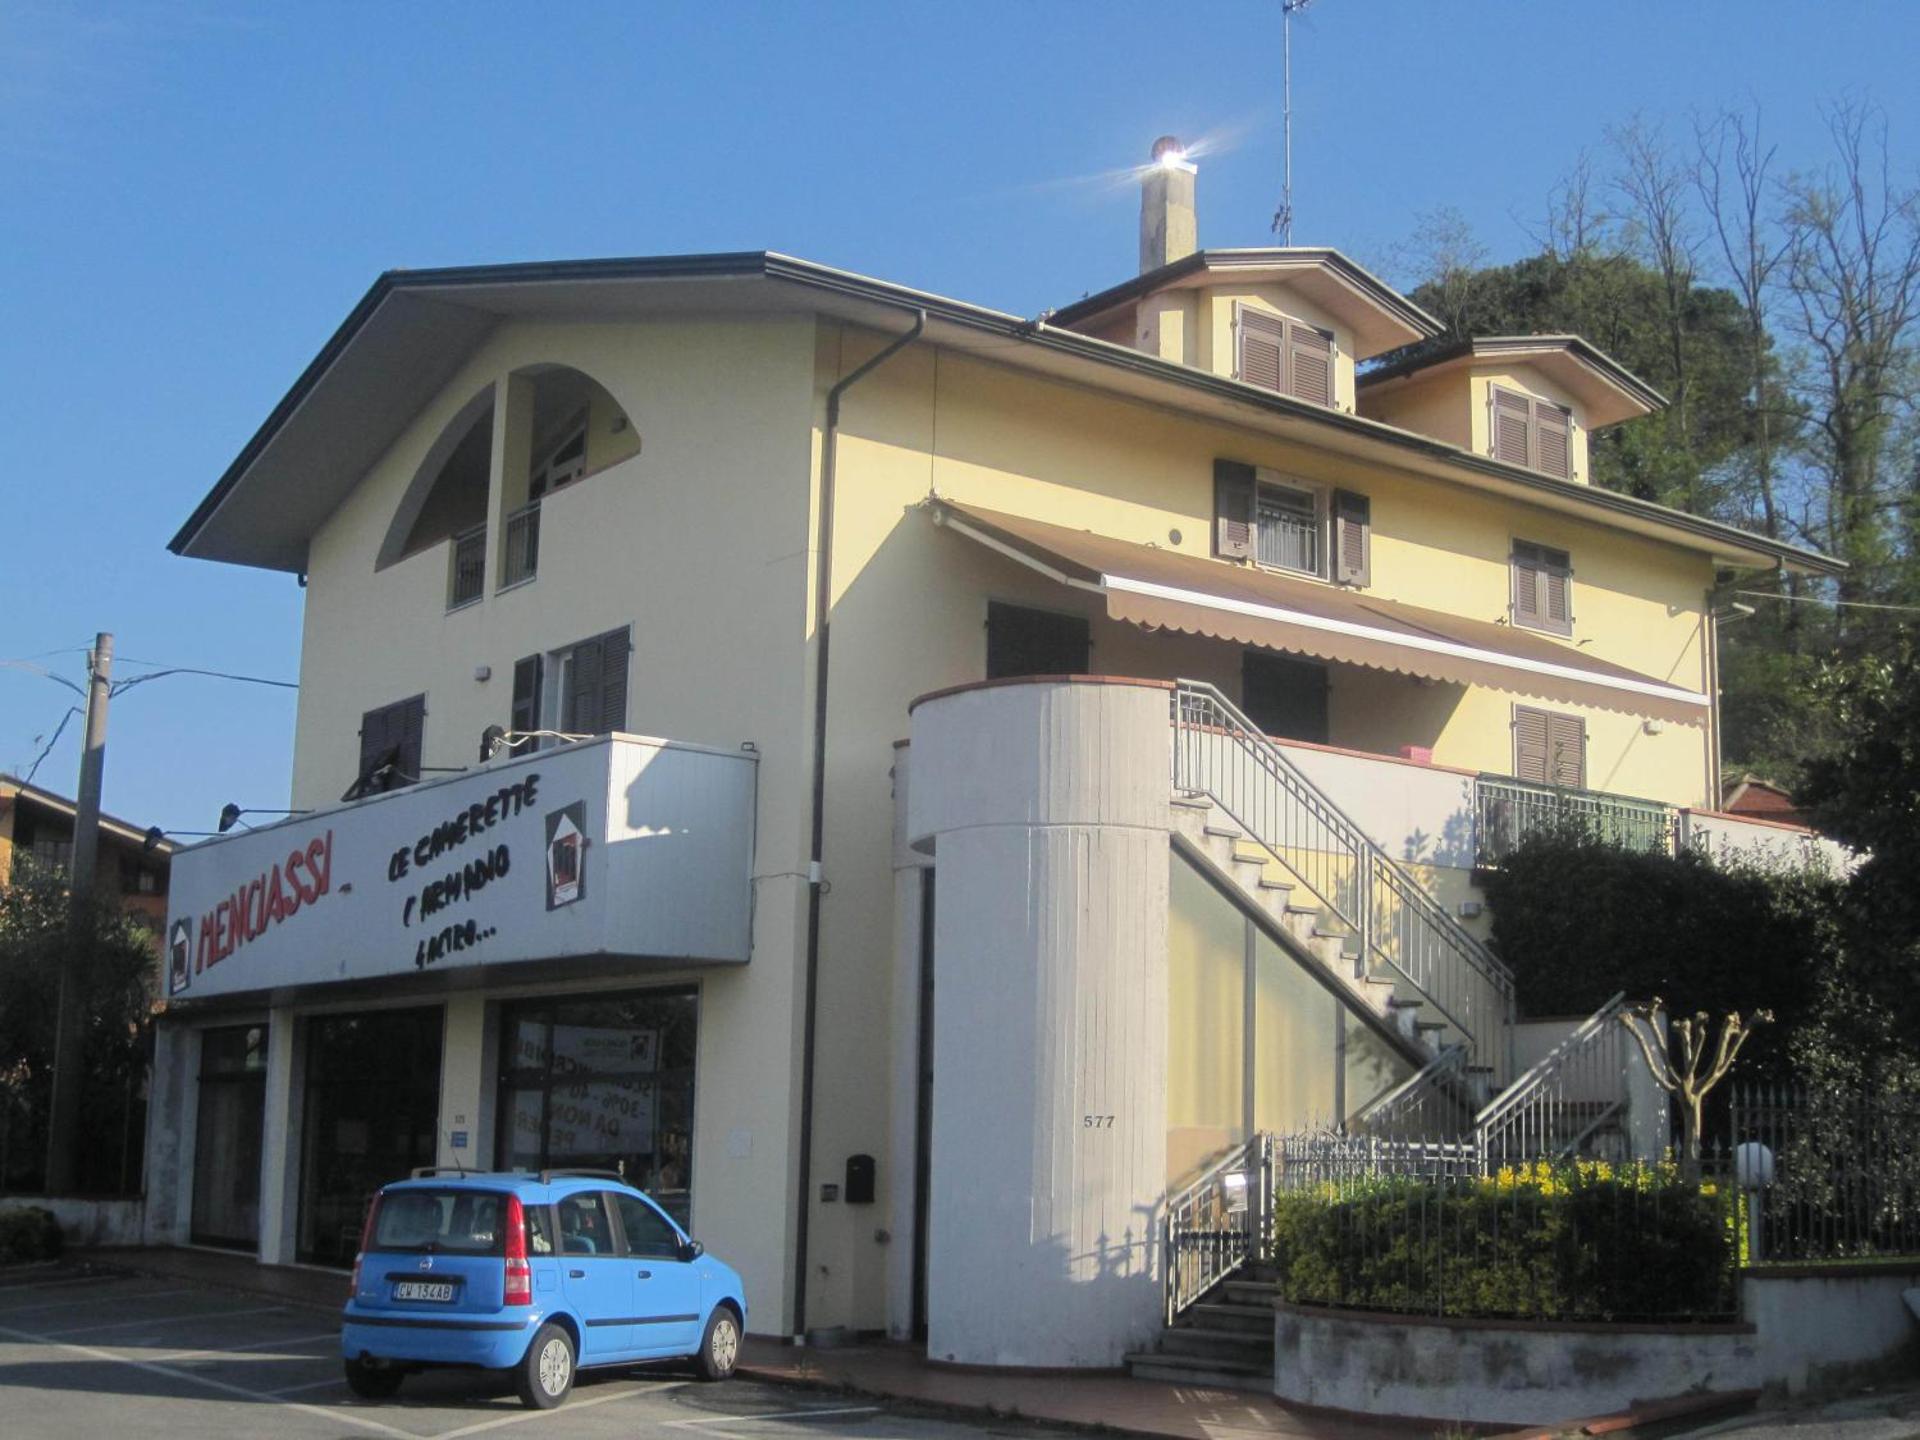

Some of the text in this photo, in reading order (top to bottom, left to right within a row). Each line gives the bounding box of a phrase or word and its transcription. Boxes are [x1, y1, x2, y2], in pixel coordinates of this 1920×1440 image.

[388, 774, 541, 882] LE CAMERETTE
[196, 830, 333, 976] MENCIASSI
[1084, 1115, 1115, 1129] 577
